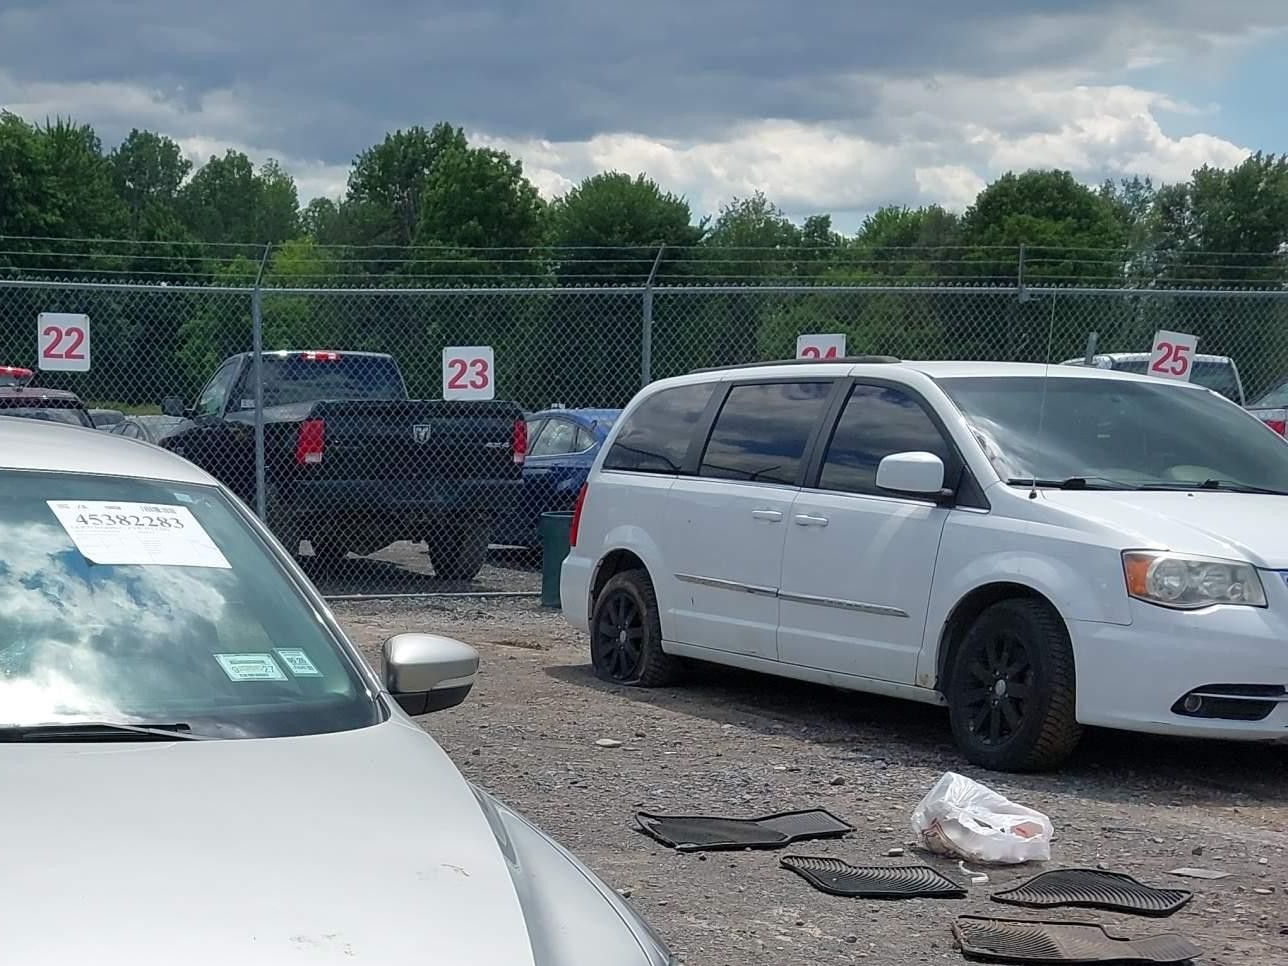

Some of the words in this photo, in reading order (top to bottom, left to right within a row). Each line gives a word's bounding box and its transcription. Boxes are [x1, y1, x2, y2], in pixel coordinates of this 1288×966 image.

[42, 326, 85, 360] 22
[1152, 342, 1190, 376] 25
[447, 358, 489, 389] 23
[75, 513, 185, 529] 45382283
